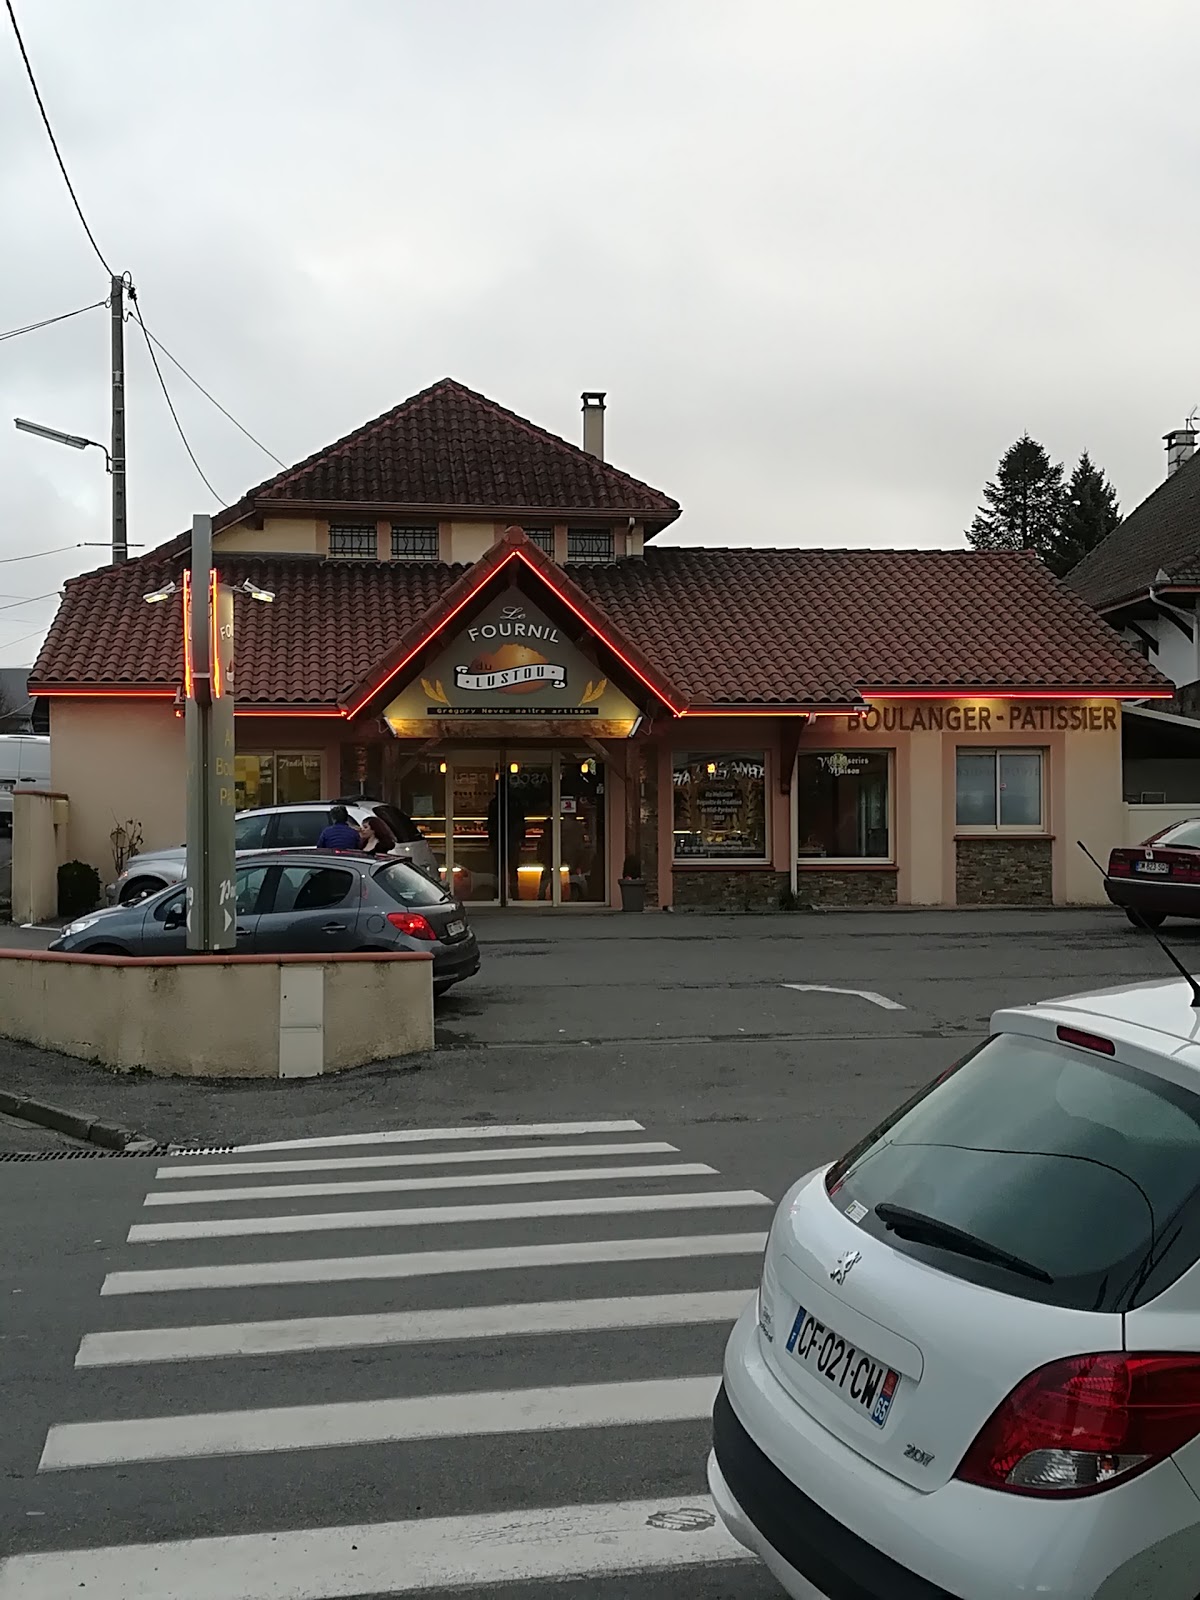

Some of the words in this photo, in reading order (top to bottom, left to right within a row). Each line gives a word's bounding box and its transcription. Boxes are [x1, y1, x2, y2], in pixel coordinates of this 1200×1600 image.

[499, 606, 526, 621] Le
[467, 622, 559, 643] FOURNIL
[475, 661, 492, 671] du
[476, 667, 544, 687] LUSTOU
[828, 766, 861, 777] Maison
[875, 1397, 889, 1421] 65
[903, 1443, 937, 1467] 207
